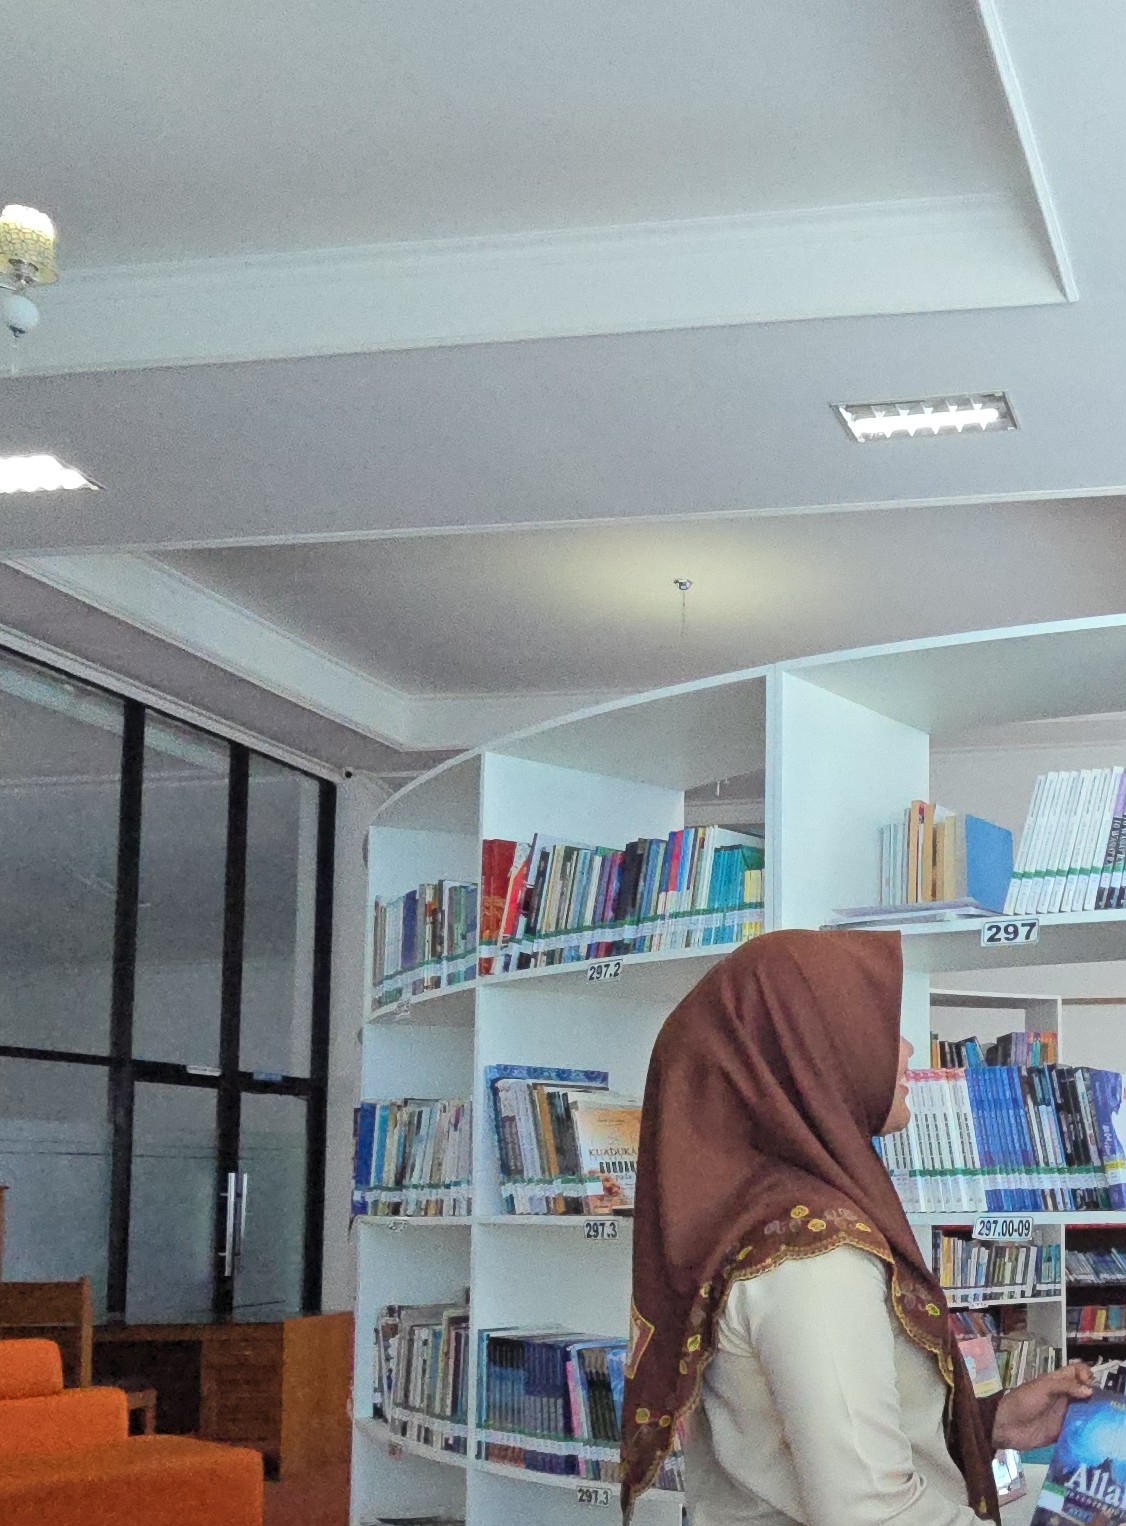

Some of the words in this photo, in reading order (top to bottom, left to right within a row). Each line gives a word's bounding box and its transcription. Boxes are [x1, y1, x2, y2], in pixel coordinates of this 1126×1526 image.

[986, 922, 1037, 943] 297
[589, 962, 621, 981] 297.2
[585, 1222, 618, 1239] 297.3
[977, 1219, 1031, 1238] 297.00-09
